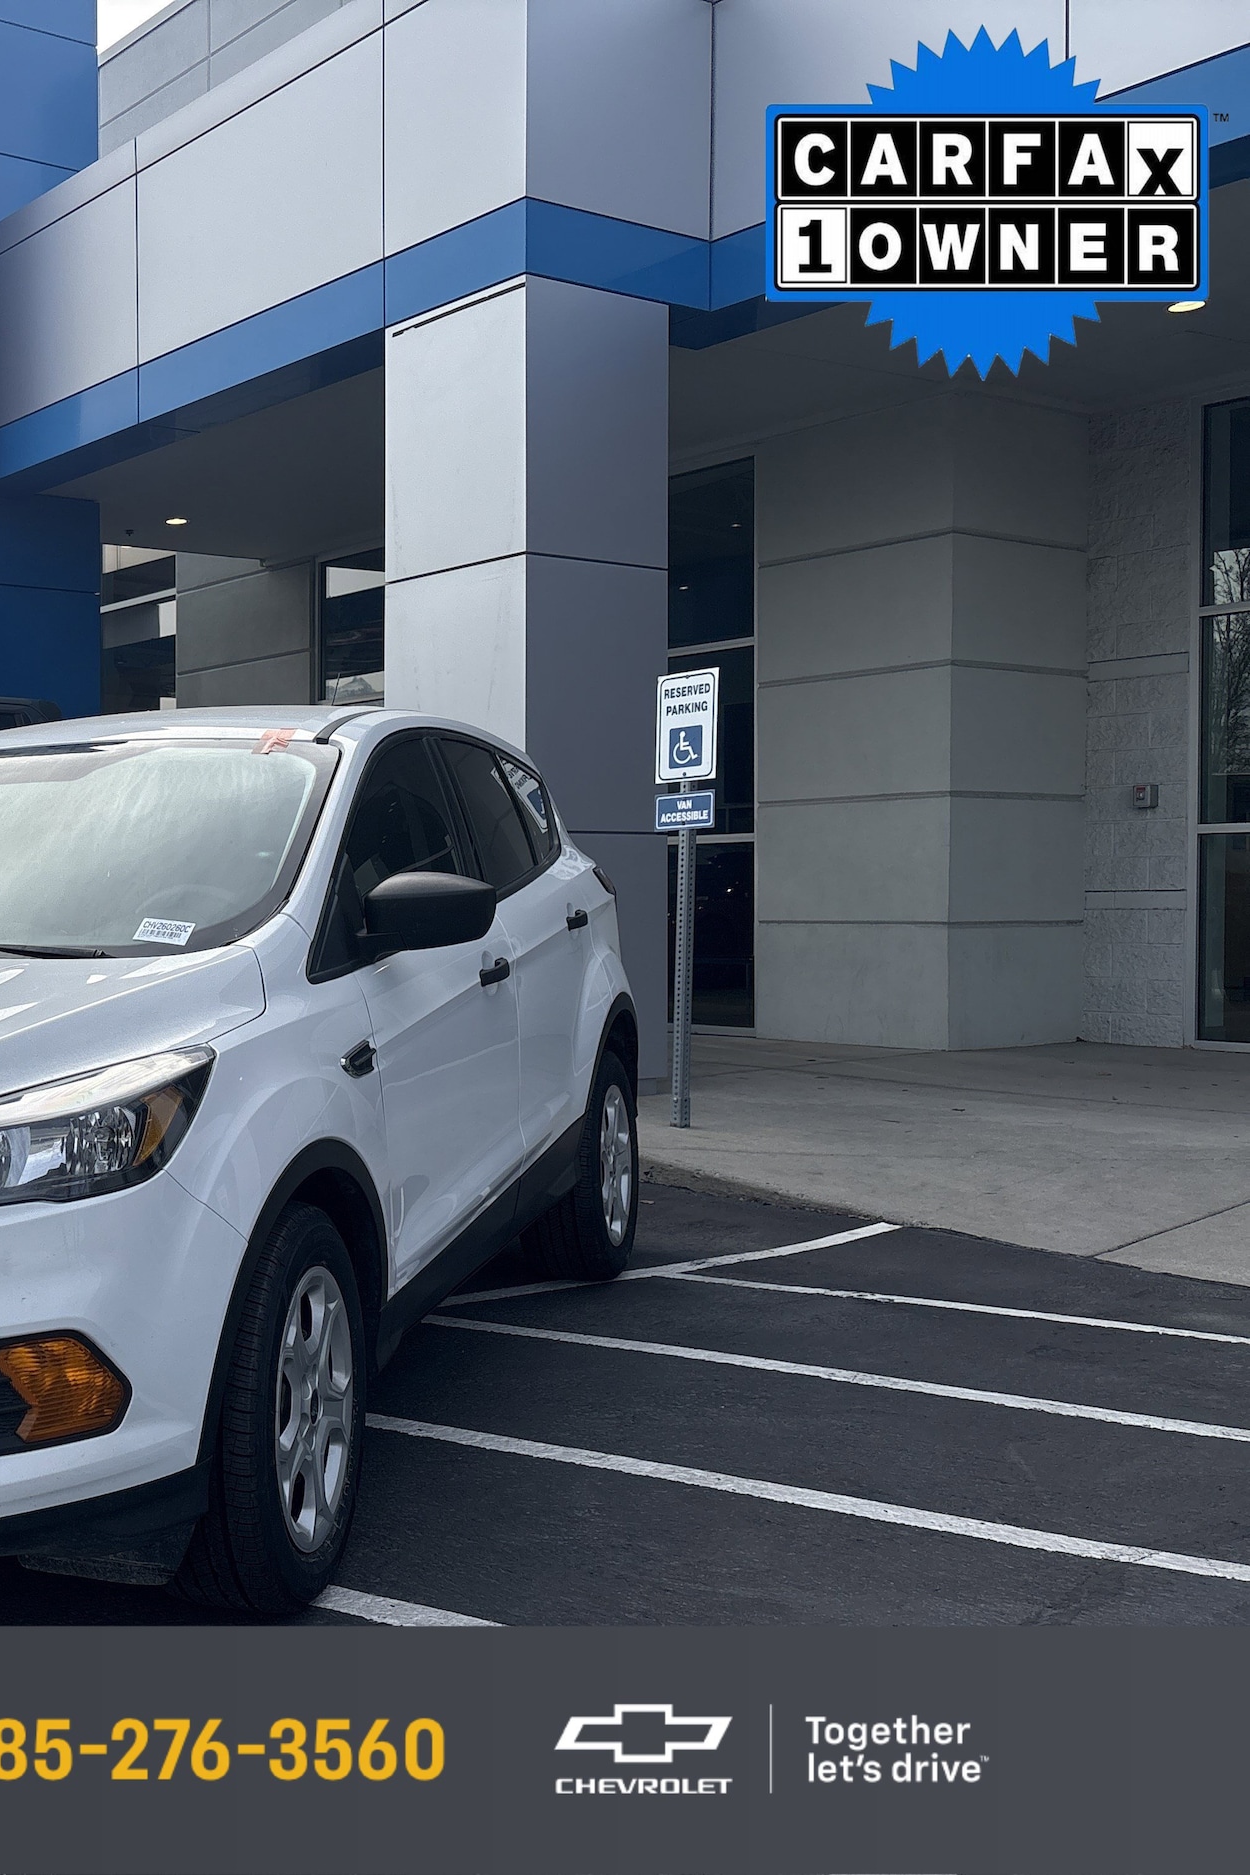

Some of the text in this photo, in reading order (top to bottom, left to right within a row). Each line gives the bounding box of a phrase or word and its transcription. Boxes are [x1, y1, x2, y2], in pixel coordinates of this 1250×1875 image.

[664, 683, 711, 699] RESERVED
[666, 701, 708, 716] PARKING
[676, 800, 692, 810] VAN
[660, 810, 709, 824] ACCESSIBLE
